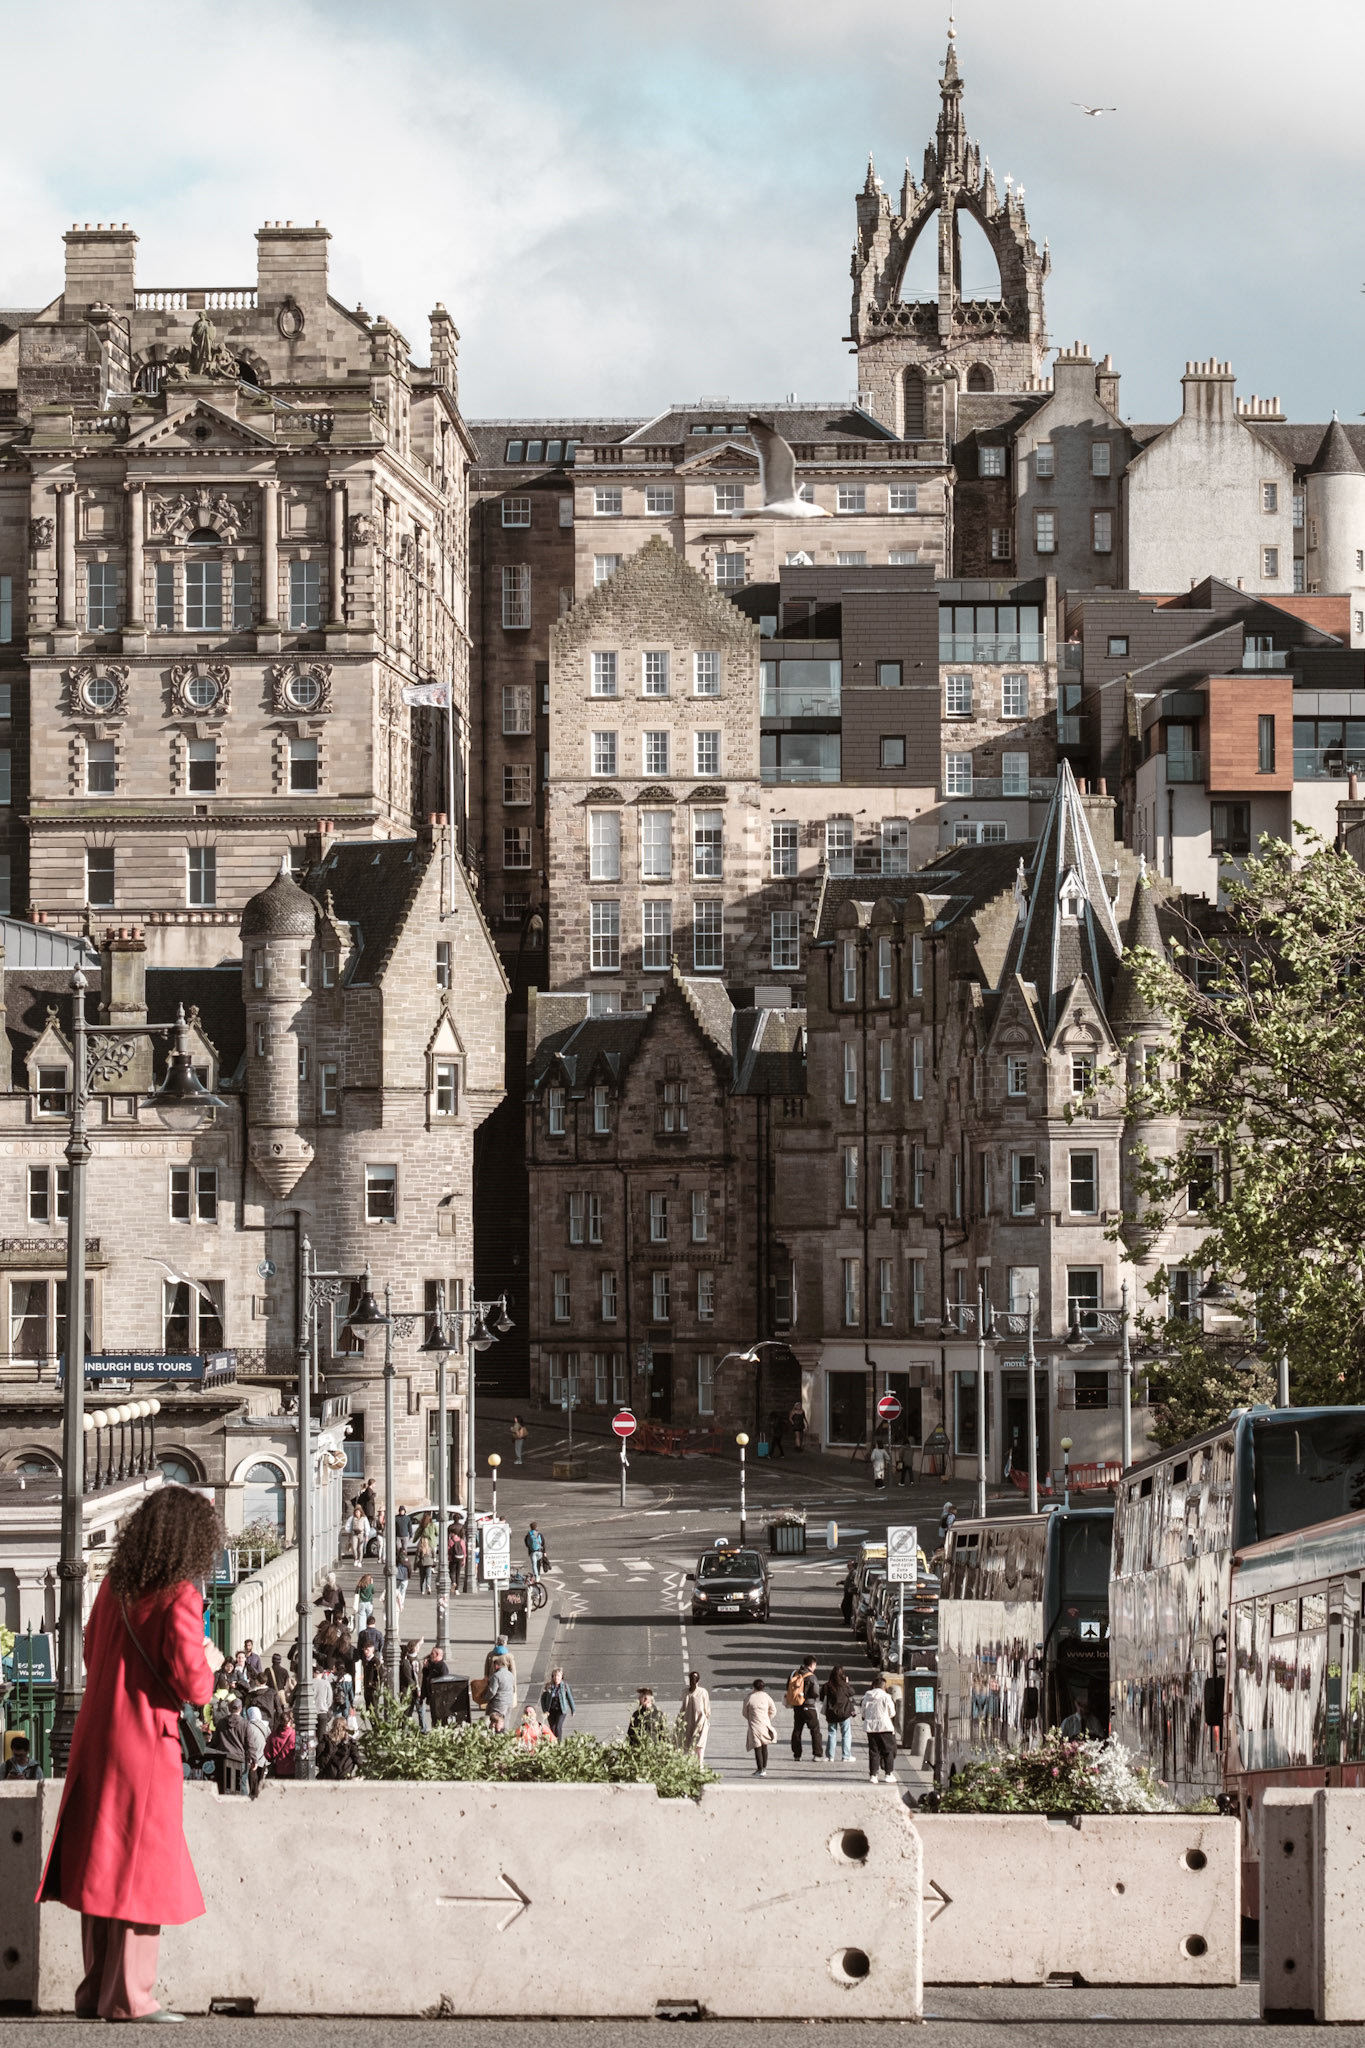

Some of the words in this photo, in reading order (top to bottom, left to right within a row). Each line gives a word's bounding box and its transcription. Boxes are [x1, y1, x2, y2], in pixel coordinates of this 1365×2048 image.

[5, 1142, 101, 1155] CKBUN
[84, 1362, 131, 1372] INBURGH
[133, 1362, 155, 1372] BUS
[156, 1362, 193, 1372] TOURS
